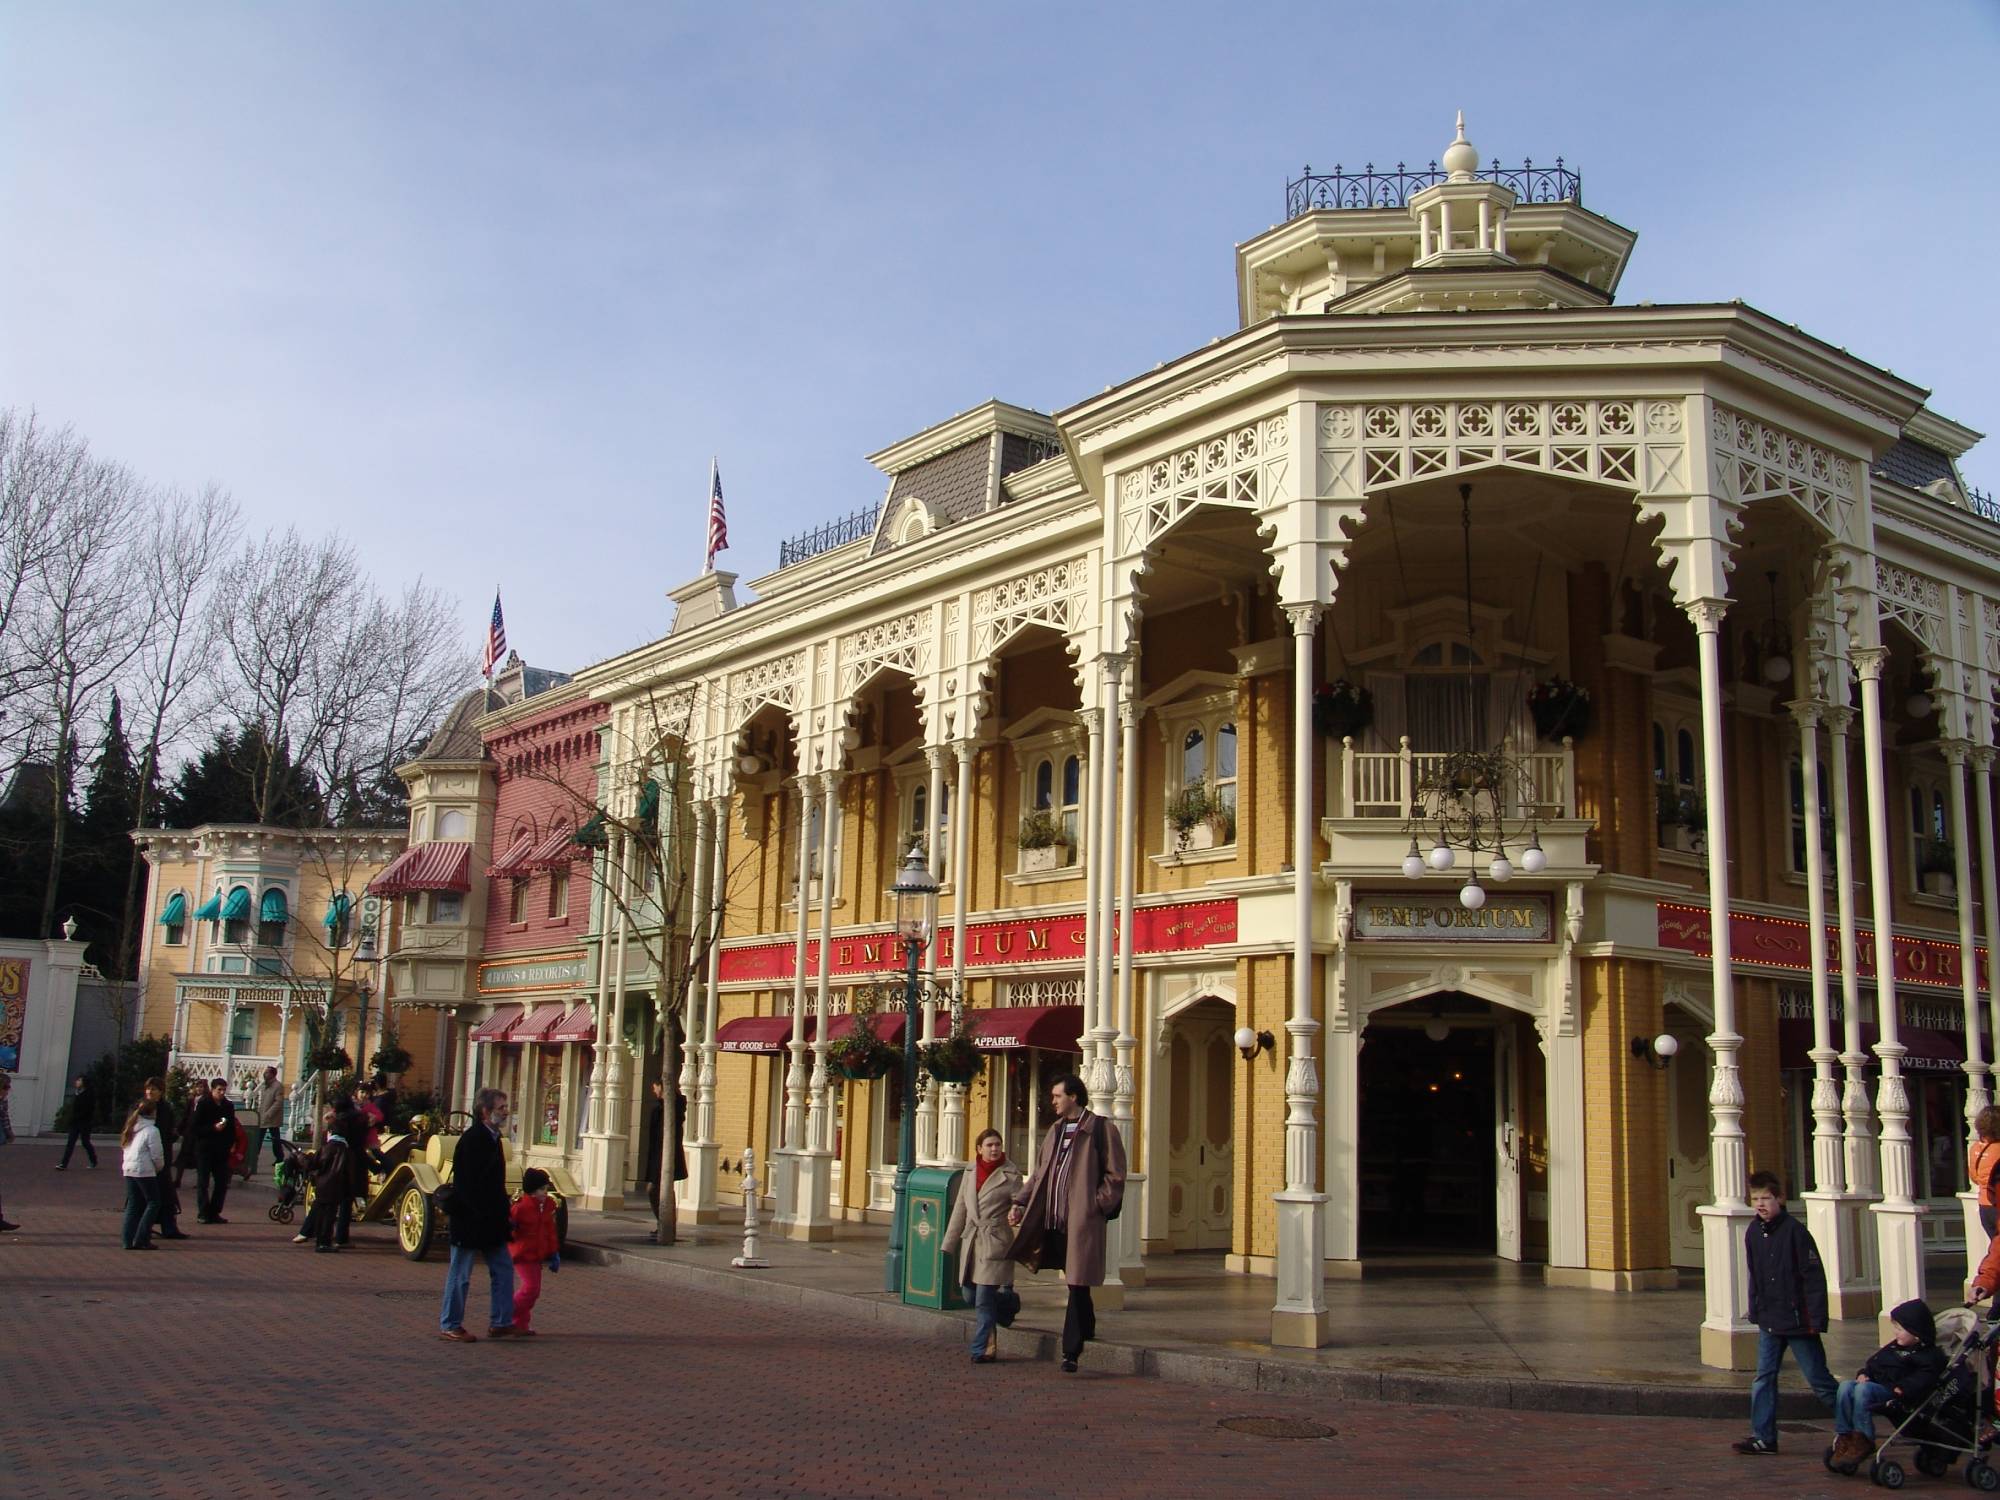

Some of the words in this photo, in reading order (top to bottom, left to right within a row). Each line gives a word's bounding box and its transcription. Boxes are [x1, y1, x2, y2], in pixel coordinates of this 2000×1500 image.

[1369, 906, 1534, 928] EMPORIUM
[838, 928, 1050, 966] EMPRIUM
[493, 969, 520, 983] BOOKS
[529, 965, 570, 981] RECORDS
[722, 1041, 738, 1050] DRY
[740, 1041, 764, 1050] GOODS
[974, 1036, 1020, 1047] APPAREL
[1900, 1056, 1961, 1070] WELRY
